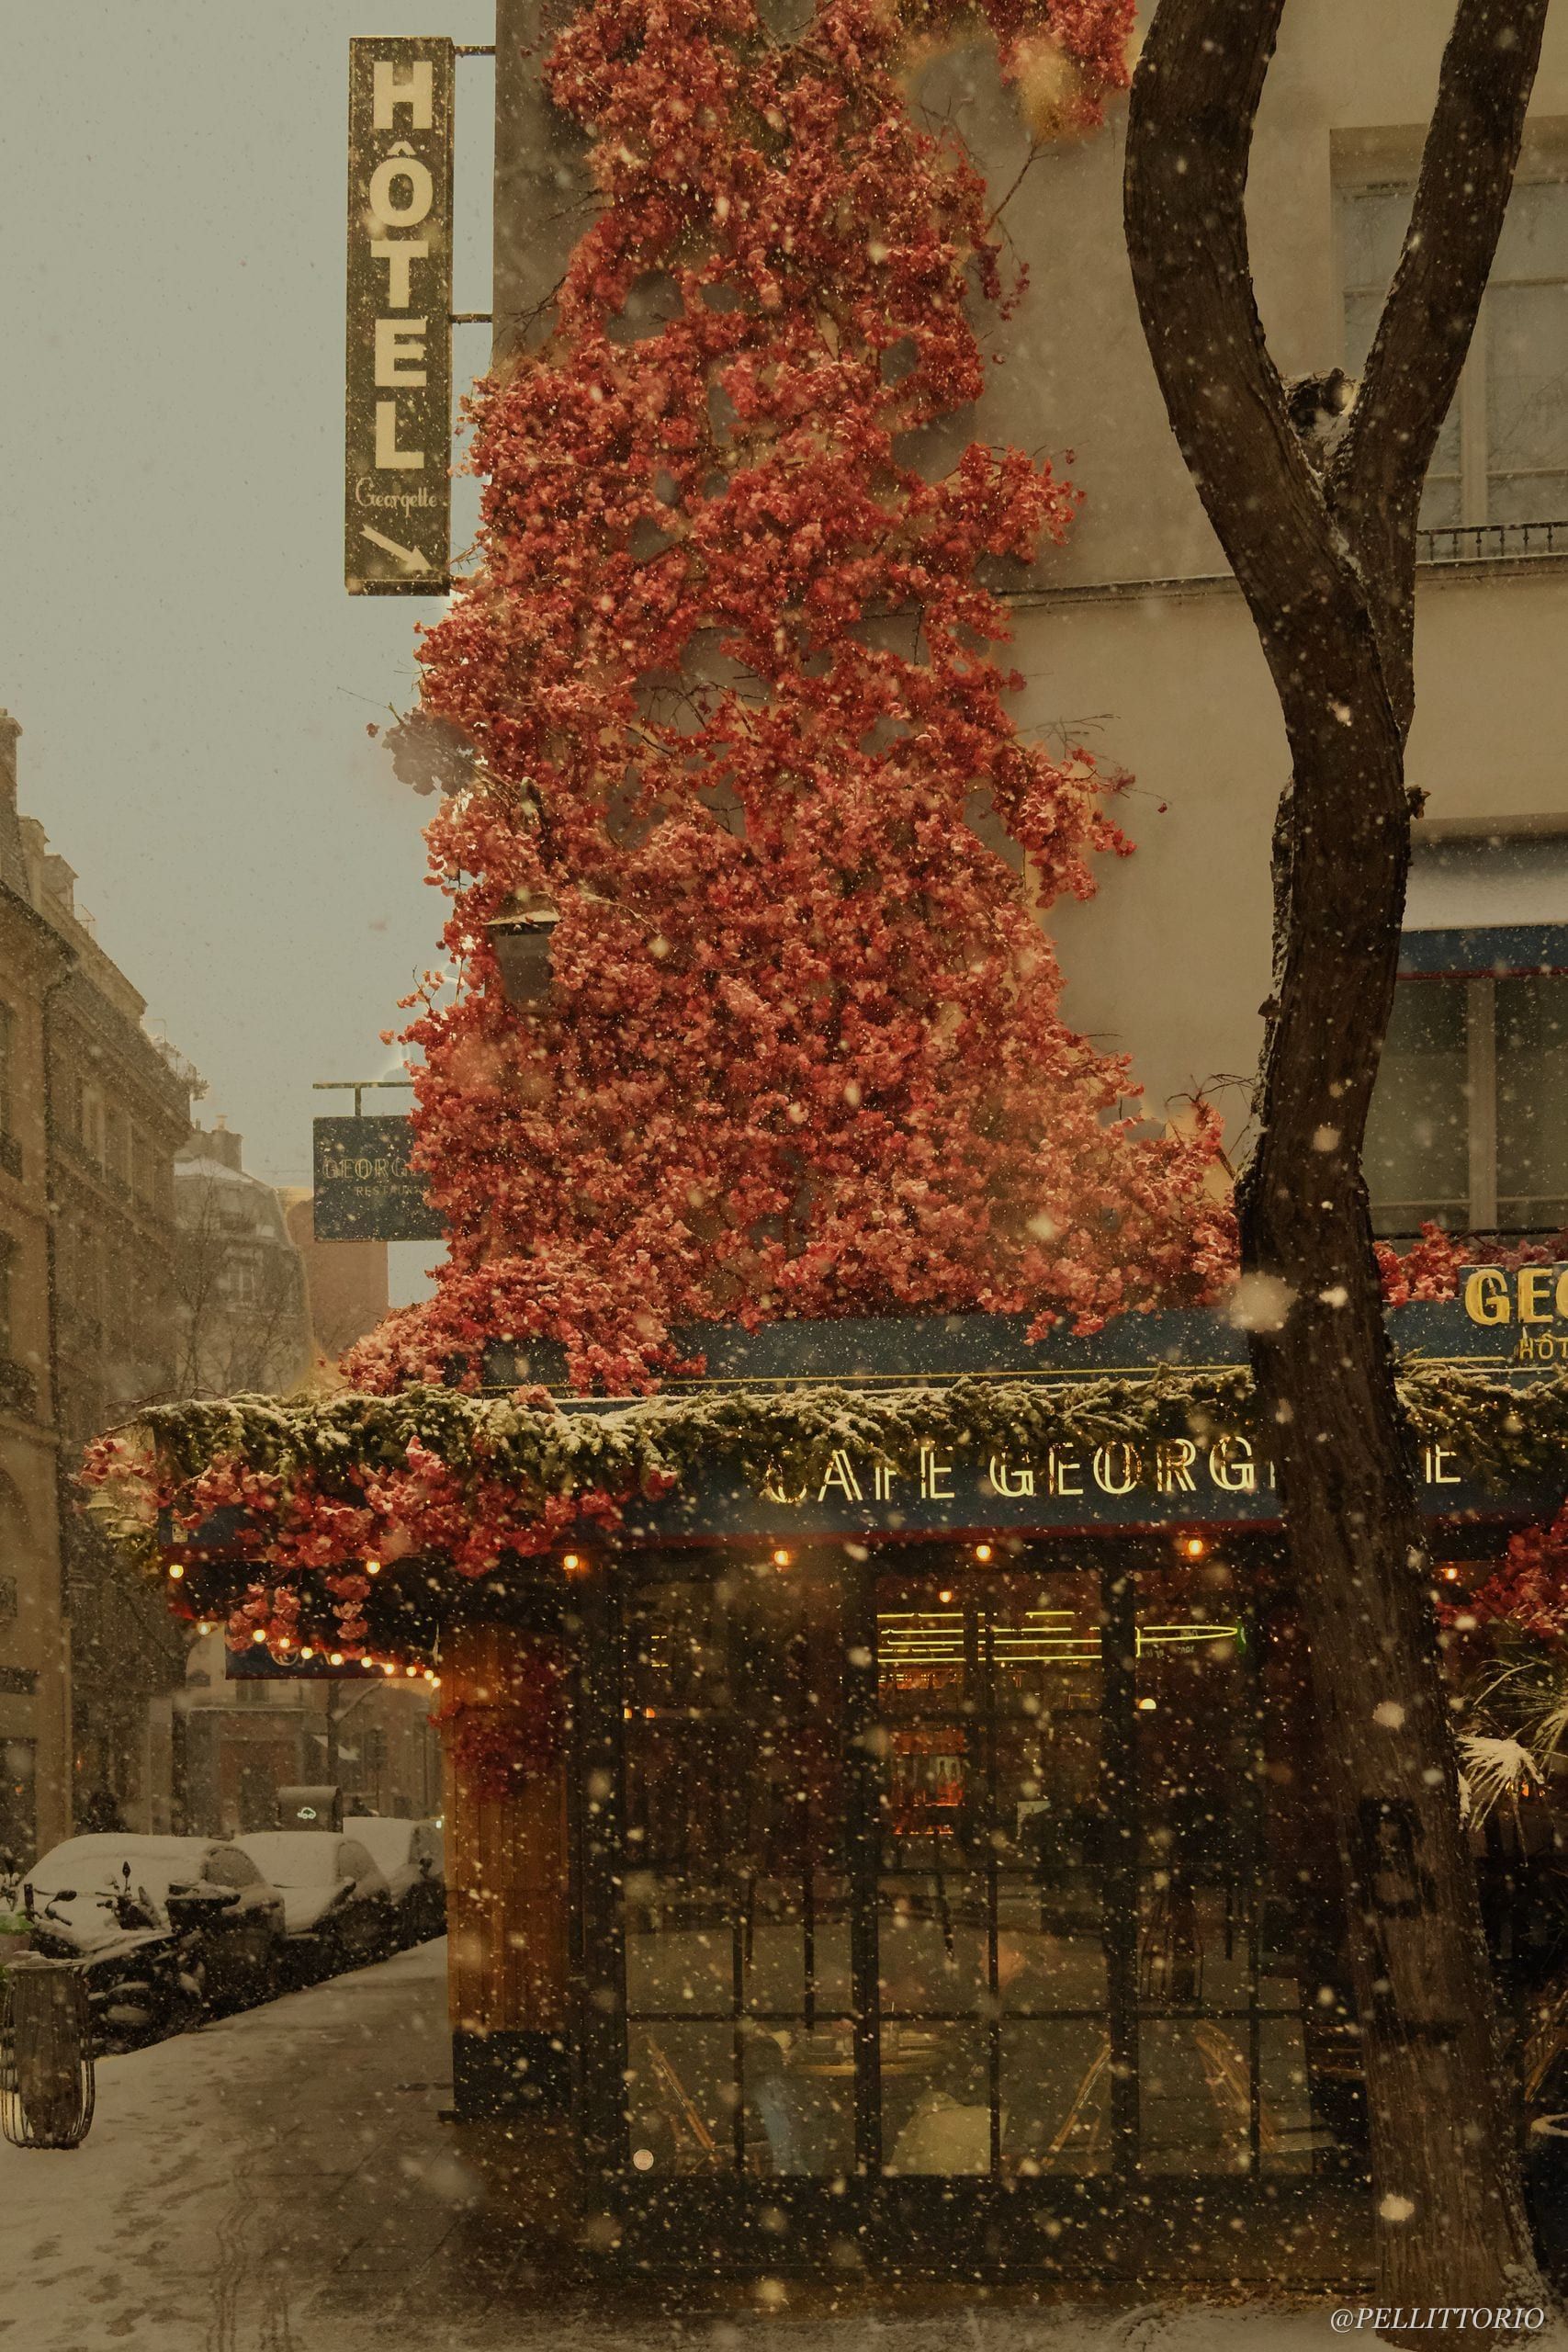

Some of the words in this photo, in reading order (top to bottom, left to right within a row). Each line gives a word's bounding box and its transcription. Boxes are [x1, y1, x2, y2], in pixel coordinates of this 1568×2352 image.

[369, 61, 433, 469] HÔTEL
[355, 477, 438, 518] Georgette
[1464, 1267, 1568, 1326] GE
